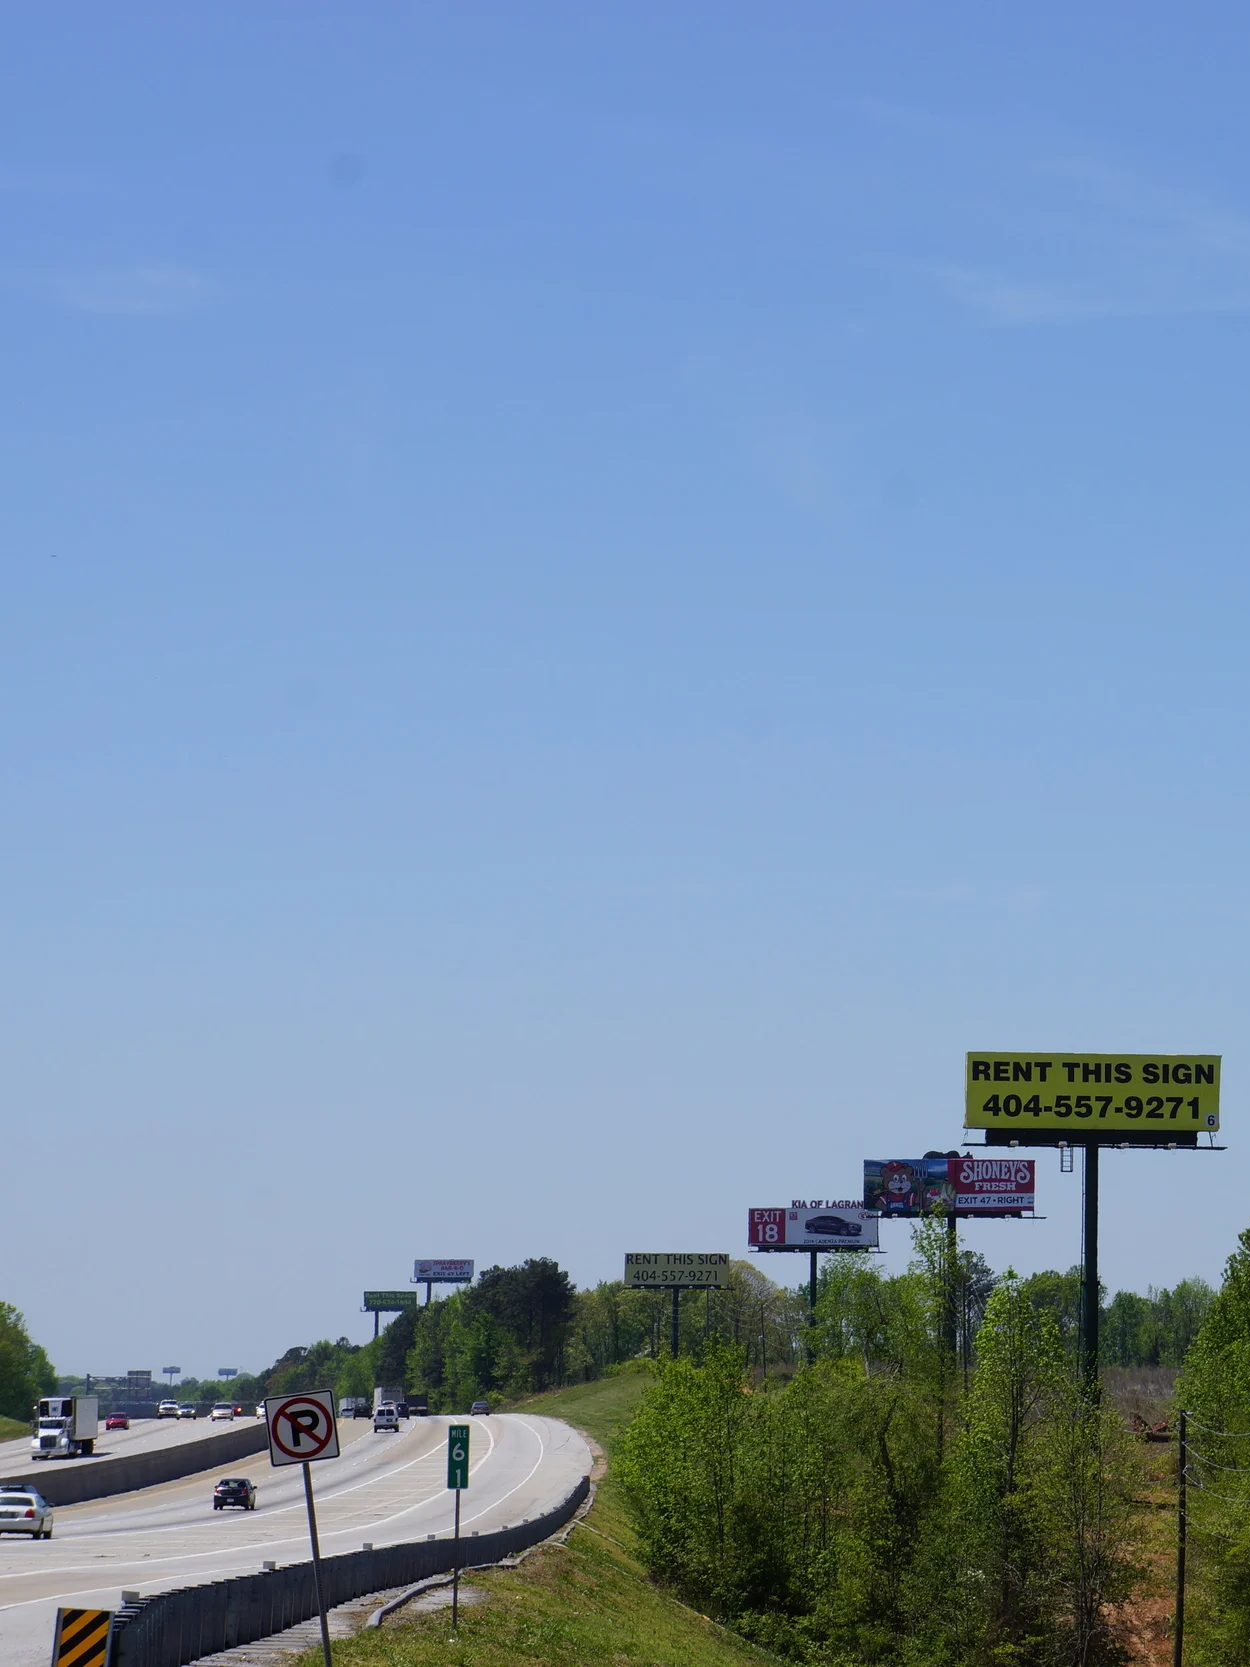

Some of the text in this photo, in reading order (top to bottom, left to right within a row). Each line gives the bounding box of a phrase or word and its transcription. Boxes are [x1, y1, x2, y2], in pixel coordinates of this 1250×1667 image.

[971, 1060, 1215, 1085] RENT THIS SIGN
[982, 1094, 1200, 1120] 404-557-9271
[1207, 1114, 1216, 1126] 6
[959, 1160, 1032, 1184] SHONEY'S
[974, 1181, 1017, 1191] FRESH
[791, 1200, 864, 1209] KIA OF LAGRAN
[958, 1196, 979, 1205] EXIT
[980, 1196, 991, 1205] 47
[997, 1196, 1025, 1205] RIGHT
[754, 1210, 782, 1222] EXIT
[757, 1223, 778, 1243] 18
[626, 1254, 727, 1265] RENT THIS SIGN
[632, 1270, 719, 1282] 404-557-9271
[451, 1429, 467, 1438] MILE
